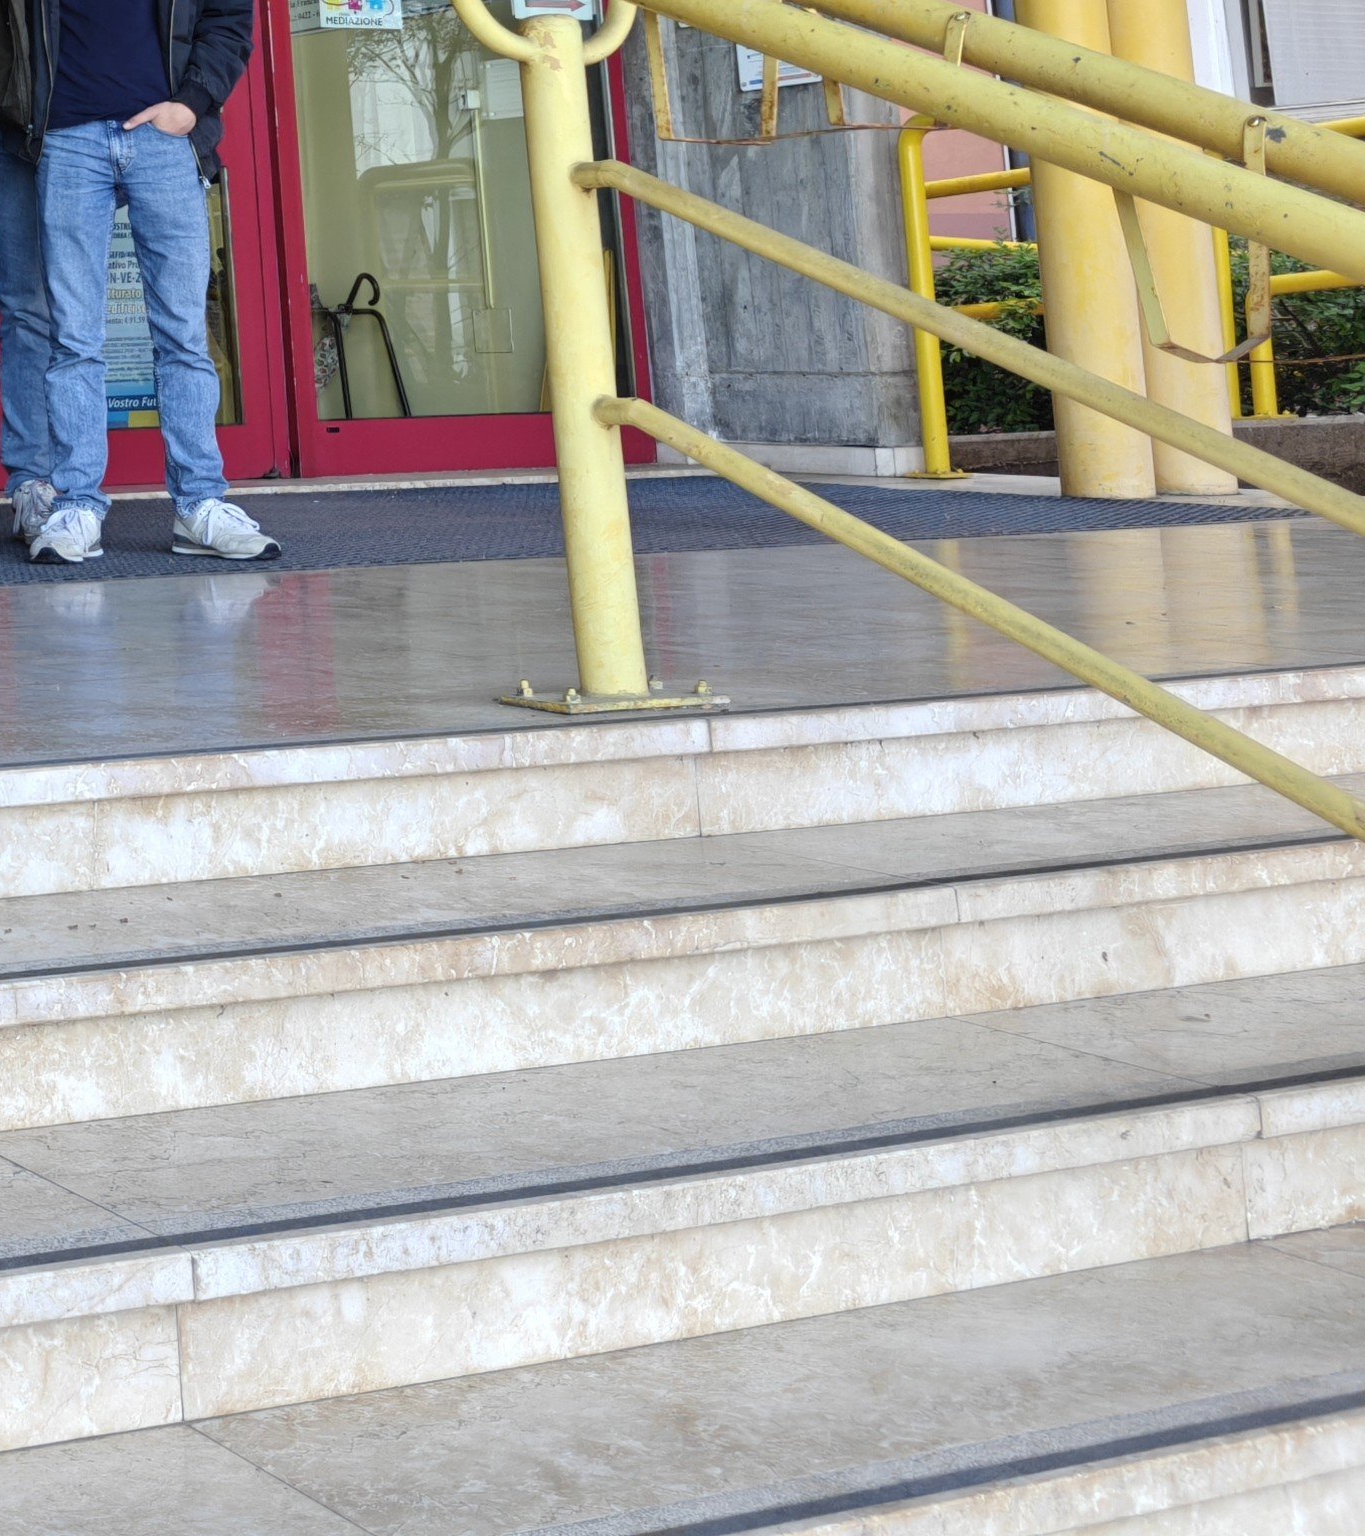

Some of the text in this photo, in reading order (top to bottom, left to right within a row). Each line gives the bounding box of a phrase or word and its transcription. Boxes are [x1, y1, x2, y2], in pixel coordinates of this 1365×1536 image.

[326, 16, 383, 26] MEDIAZIONE
[108, 395, 157, 409] Vostro Fut
